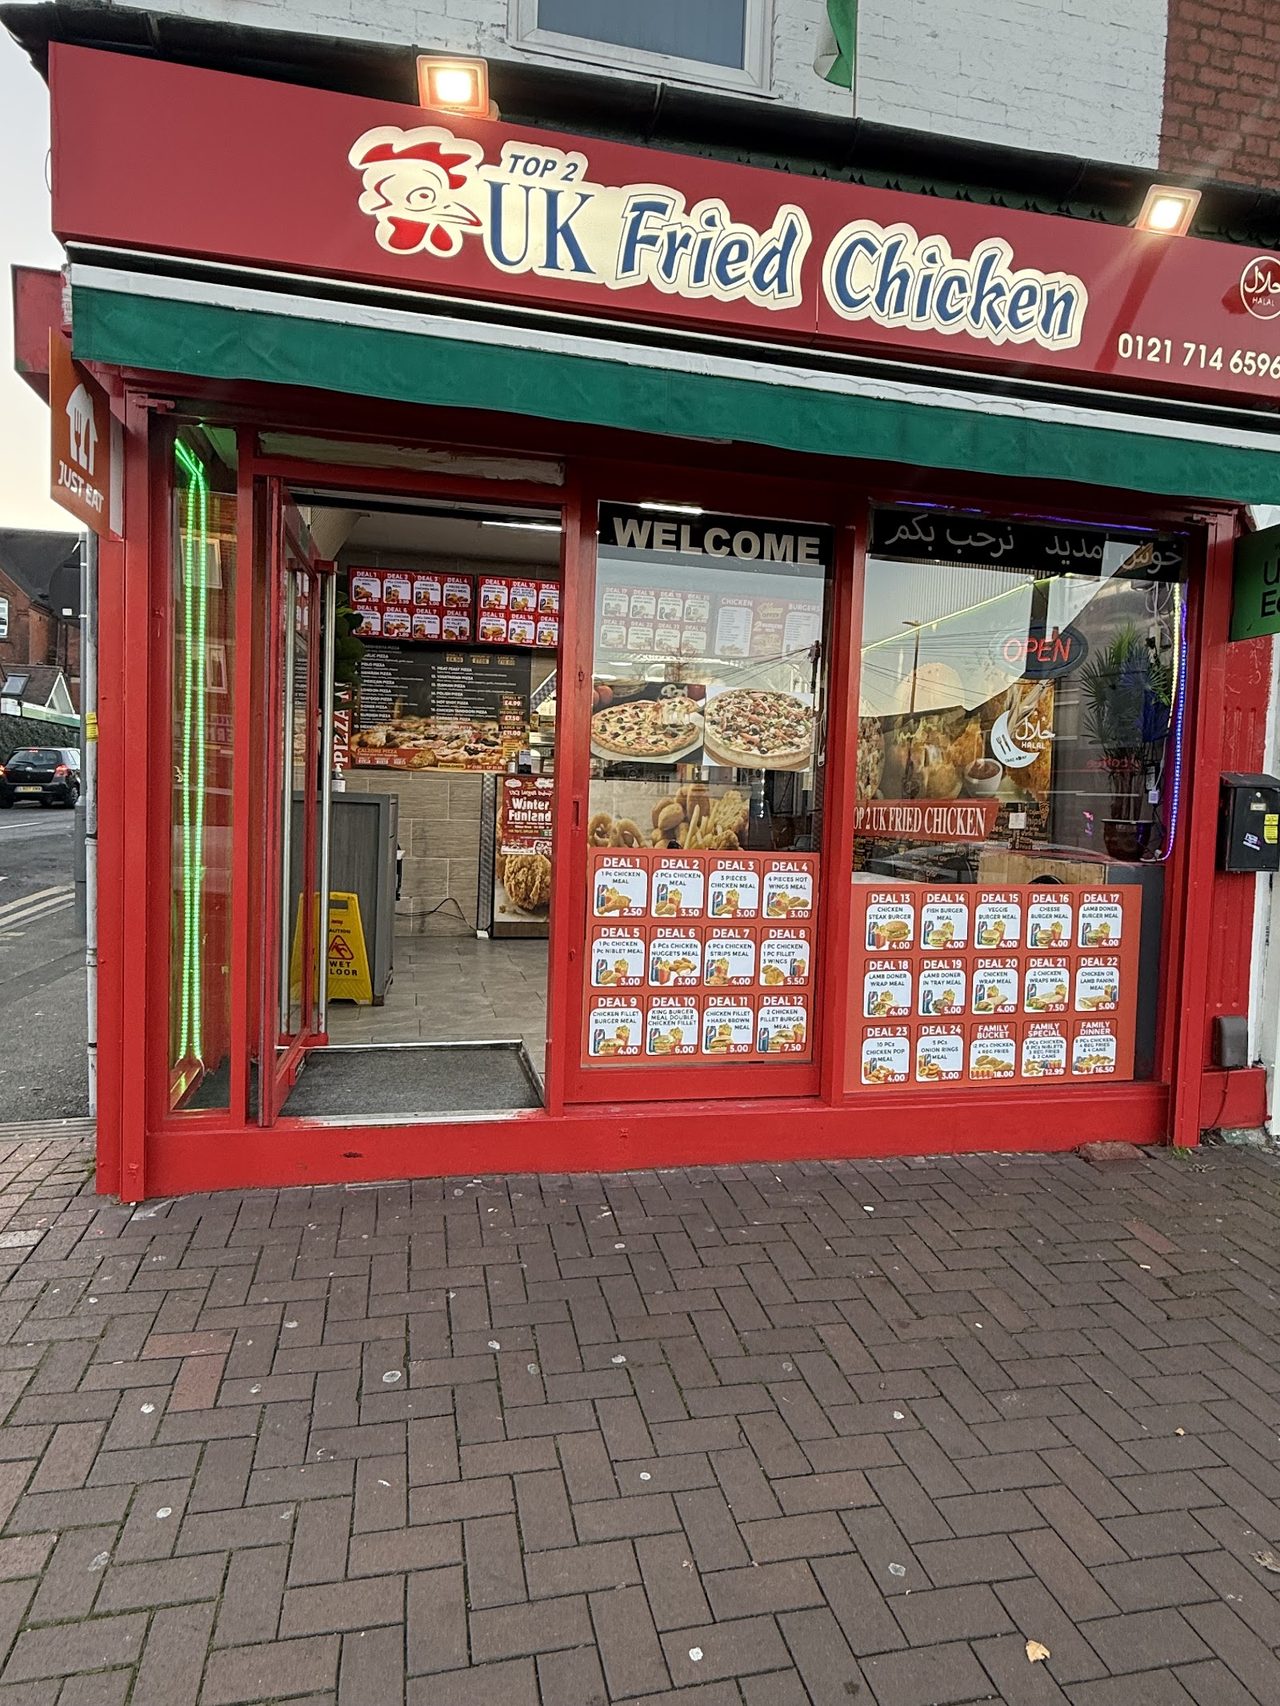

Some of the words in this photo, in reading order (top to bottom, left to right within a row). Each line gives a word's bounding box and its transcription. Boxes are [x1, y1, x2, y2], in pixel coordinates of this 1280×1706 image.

[508, 153, 557, 178] TOP
[560, 162, 579, 182] 2
[484, 179, 597, 275] UK
[616, 194, 803, 299] Fried
[832, 230, 1078, 341] Chicken
[1252, 297, 1275, 307] HALAL
[1118, 333, 1173, 364] 0121
[1183, 342, 1223, 371] 714
[1230, 350, 1280, 380] 6596
[58, 460, 84, 497] JUST
[85, 483, 104, 513] EAT
[613, 517, 820, 565] WELCOME
[721, 598, 752, 606] CHICKEN
[1004, 638, 1071, 662] OPEN
[334, 709, 349, 763] PIZZA
[1021, 741, 1046, 749] HALAL
[512, 797, 550, 810] Winter
[509, 810, 551, 821] Funland
[854, 808, 863, 830] OP
[866, 808, 870, 830] 2
[873, 808, 886, 831] UK
[889, 808, 921, 833] FRIED
[925, 808, 986, 836] CHICKEN
[603, 858, 631, 868] DEAL
[636, 859, 640, 868] 1
[661, 859, 690, 869] DEAL
[693, 860, 699, 869] 2
[717, 860, 746, 870] DEAL
[748, 861, 754, 871] 3
[772, 862, 799, 871] DEAL
[801, 863, 808, 871] 4
[872, 894, 898, 903] DEAL
[901, 894, 910, 903] 13
[927, 894, 953, 902] DEAL
[955, 894, 964, 903] 14
[982, 894, 1006, 902] DEAL
[1009, 894, 1018, 902] 15
[1032, 894, 1057, 903] DEAL
[1059, 894, 1069, 903] 16
[1084, 894, 1108, 903] DEAL
[1110, 894, 1120, 903] 17
[623, 908, 642, 916] 2.50
[736, 910, 756, 918] 5.00
[790, 910, 809, 918] 3.00
[601, 928, 629, 937] DEAL
[633, 929, 640, 938] 5
[657, 929, 686, 938] DEAL
[688, 929, 695, 938] 6
[713, 929, 741, 938] DEAL
[743, 929, 750, 938] 7
[769, 930, 797, 938] DEAL
[799, 929, 805, 938] 8
[946, 941, 964, 949] 4.00
[870, 961, 896, 970] DEAL
[899, 961, 908, 969] 18
[924, 960, 949, 969] DEAL
[952, 960, 961, 968] 19
[978, 959, 1003, 968] DEAL
[1006, 959, 1017, 967] 20
[1030, 959, 1055, 967] DEAL
[1057, 959, 1065, 967] 21
[1081, 958, 1104, 966] DEAL
[1107, 958, 1117, 966] 22
[621, 977, 640, 986] 3.00
[678, 977, 697, 986] 3.00
[731, 977, 750, 985] 4.00
[787, 977, 804, 985] 5.50
[598, 997, 627, 1007] DEAL
[630, 998, 637, 1007] 9
[653, 997, 682, 1007] DEAL
[684, 997, 695, 1007] 10
[709, 997, 737, 1006] DEAL
[739, 997, 747, 1006] 11
[763, 997, 792, 1005] DEAL
[794, 997, 803, 1006] 12
[890, 1008, 908, 1016] 4.00
[867, 1027, 893, 1036] DEAL
[896, 1027, 907, 1036] 23
[922, 1026, 948, 1035] DEAL
[950, 1025, 961, 1034] 24
[1028, 1029, 1061, 1037] SPECIAL
[618, 1046, 638, 1055] 4.00
[675, 1046, 694, 1054] 6.00
[729, 1044, 748, 1053] 5.00
[784, 1044, 802, 1052] 7.50
[887, 1074, 905, 1082] 4.00
